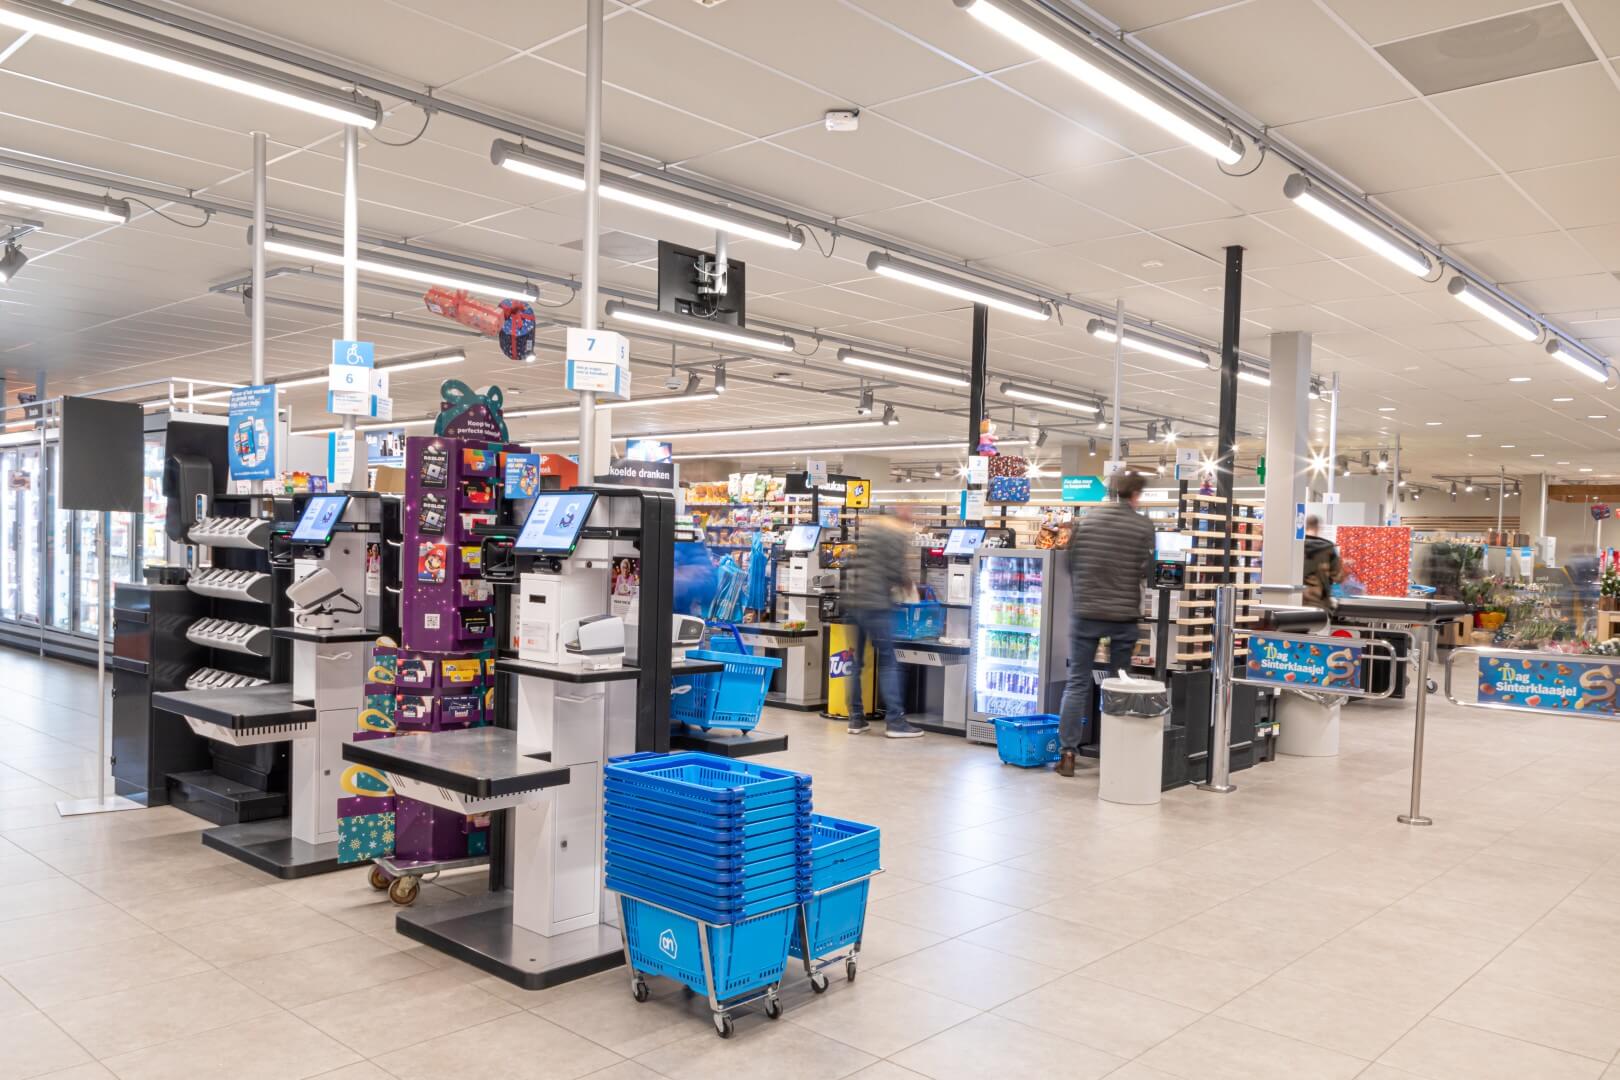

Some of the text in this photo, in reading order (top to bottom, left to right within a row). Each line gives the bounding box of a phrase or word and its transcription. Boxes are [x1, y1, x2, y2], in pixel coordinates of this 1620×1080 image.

[587, 337, 596, 351] 7
[345, 373, 354, 384] 6
[609, 467, 670, 480] koelde dranken
[422, 502, 445, 510] ROBLOX
[1264, 642, 1288, 662] Dag
[1260, 659, 1325, 675] Sinterklaasje!
[1498, 662, 1530, 684] Dag
[1495, 681, 1577, 698] Sinterklaasje!
